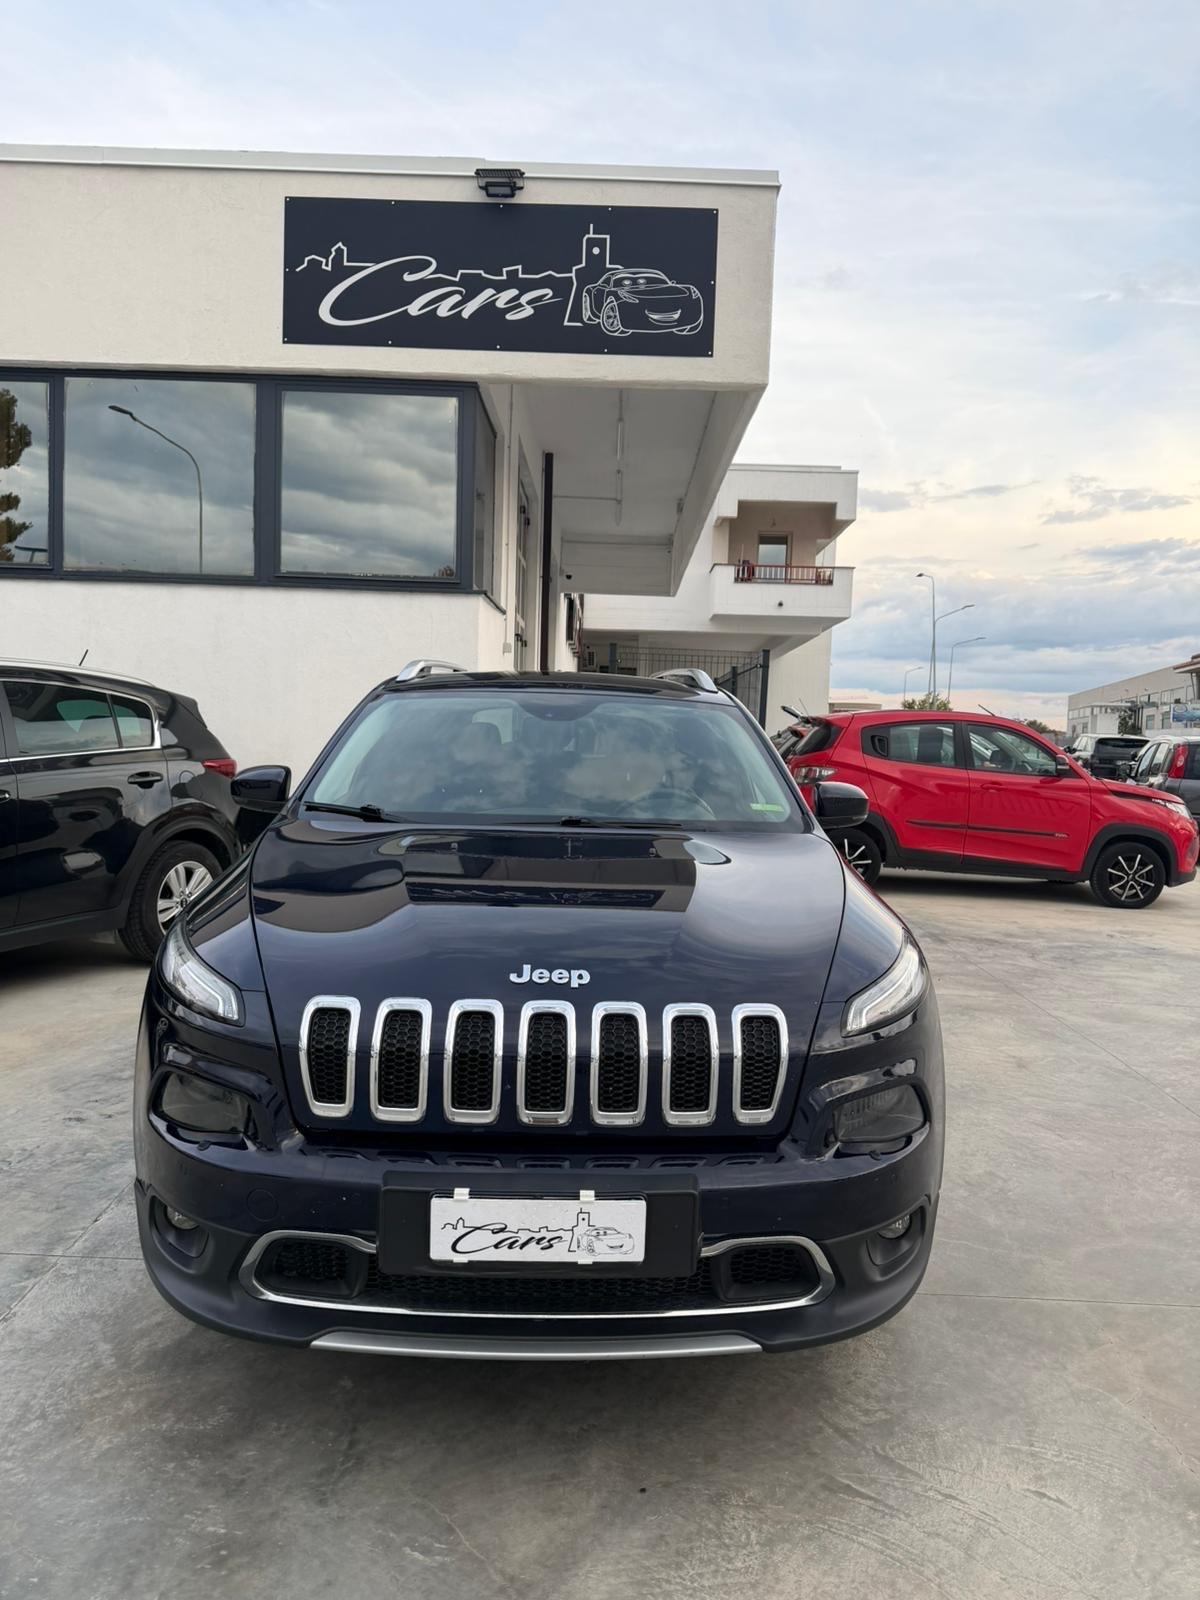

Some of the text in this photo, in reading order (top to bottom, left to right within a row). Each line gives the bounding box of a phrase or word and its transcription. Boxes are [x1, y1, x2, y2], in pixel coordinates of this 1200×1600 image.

[318, 255, 562, 326] Cars
[509, 964, 591, 988] Jeep
[451, 1223, 566, 1254] Cars
